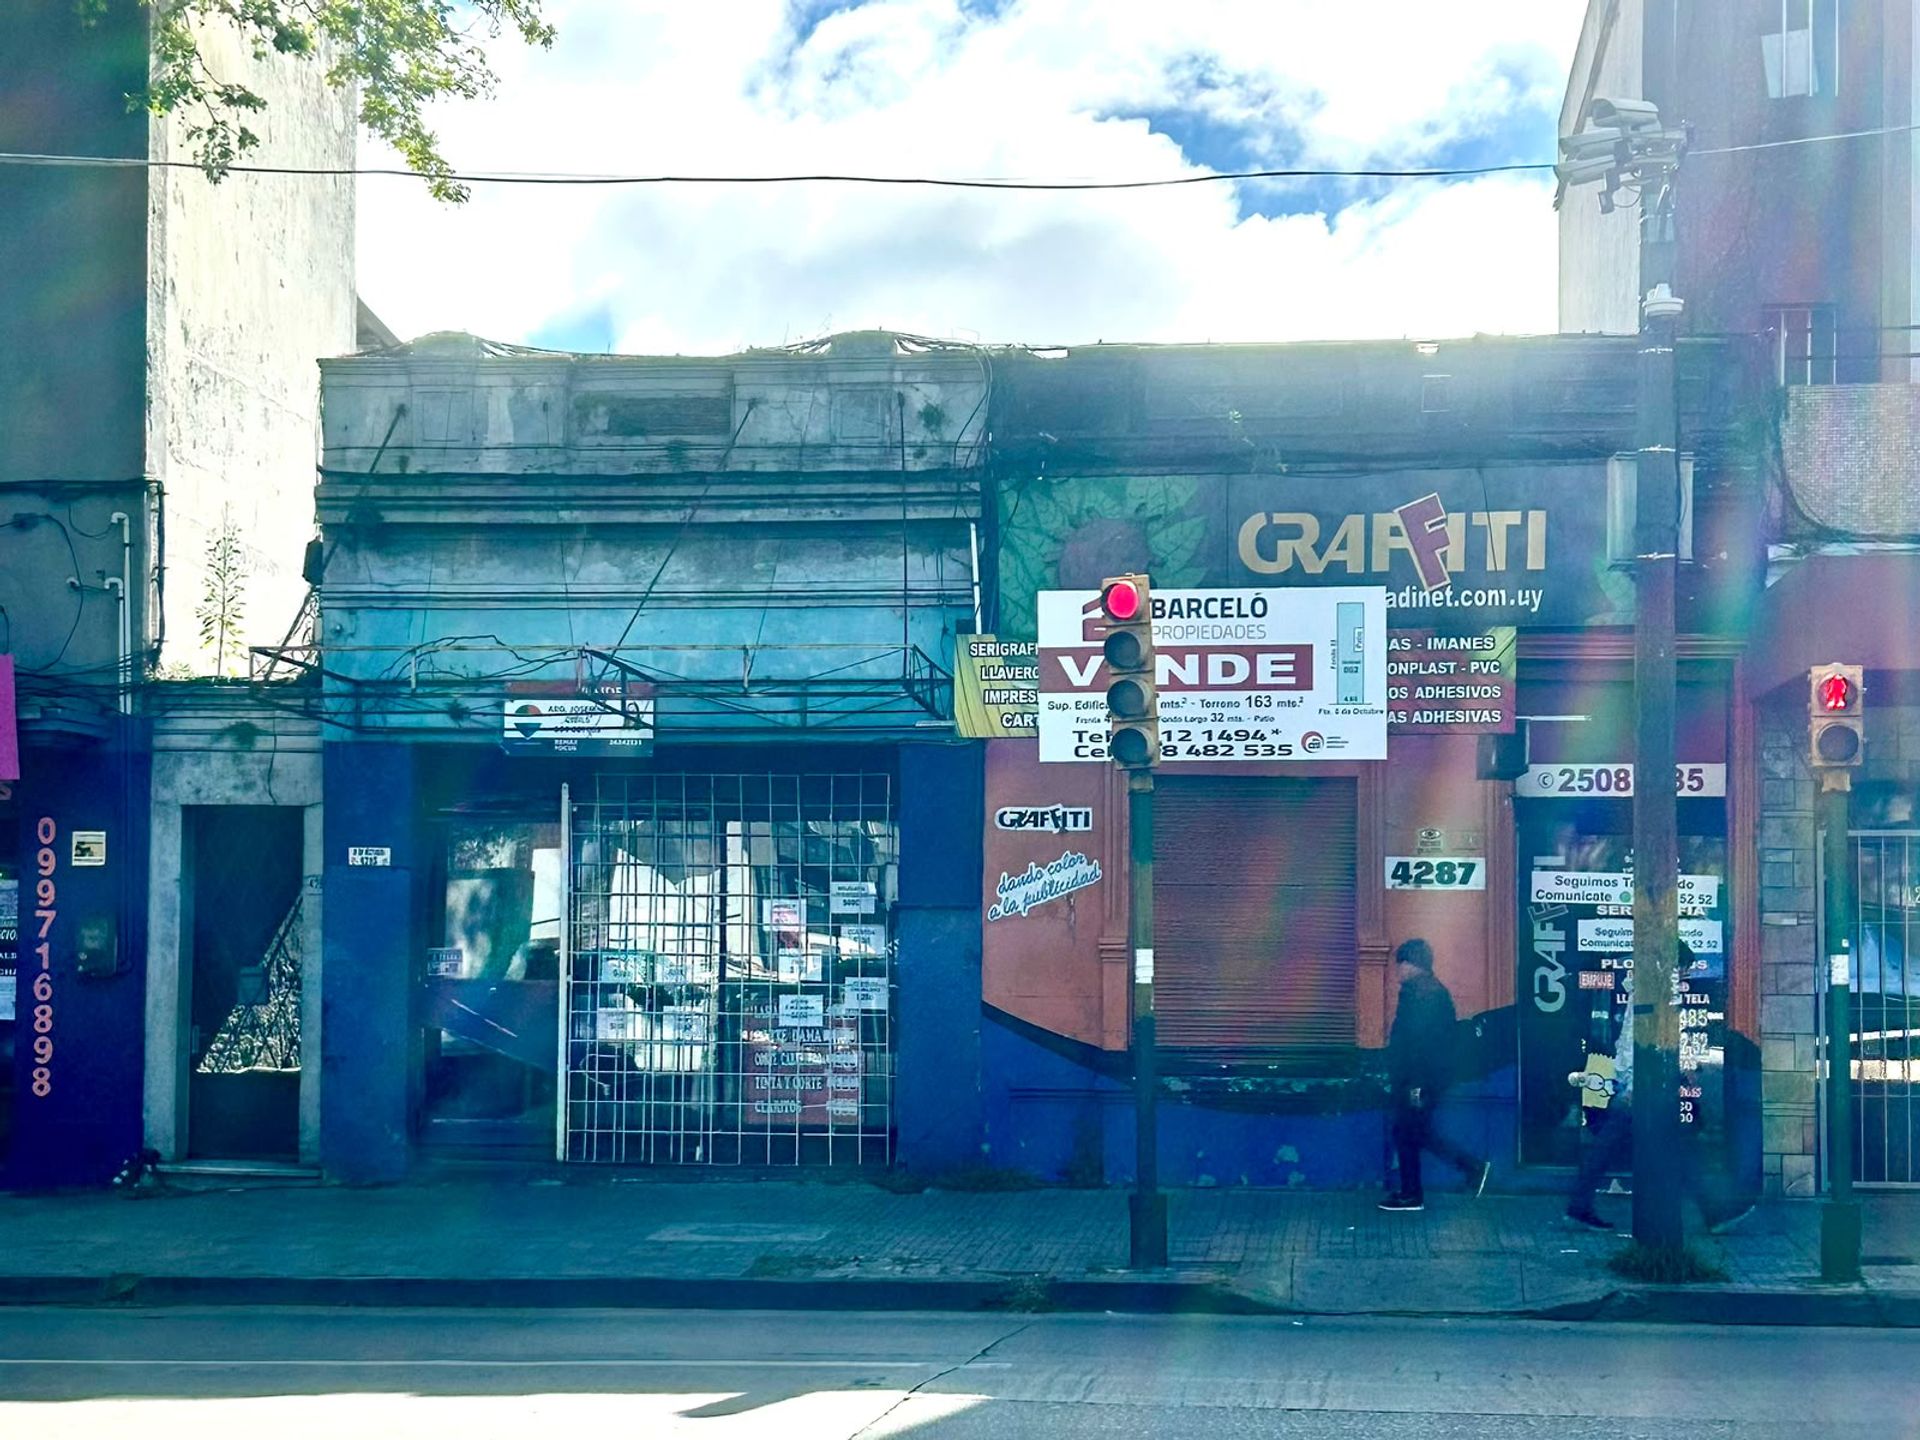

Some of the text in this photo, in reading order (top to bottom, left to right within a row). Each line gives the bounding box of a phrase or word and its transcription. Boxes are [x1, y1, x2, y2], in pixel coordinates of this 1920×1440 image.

[1238, 492, 1547, 591] GRAFFITI
[1152, 593, 1268, 619] BARCELÓ
[1152, 625, 1267, 640] PROPIEDADES
[1427, 638, 1495, 650] IMANES
[1057, 653, 1296, 686] VNDE
[1470, 661, 1500, 674] PVC
[1415, 686, 1501, 699] ADHESIVOS
[1245, 695, 1272, 708] 163
[1210, 713, 1224, 722] 32
[1412, 710, 1502, 723] ADHESIVAS
[1185, 744, 1234, 757] 482
[1244, 744, 1293, 756] 535
[998, 808, 1090, 829] GRAFFITI
[1047, 853, 1085, 875] color
[1391, 861, 1477, 885] 4287
[1554, 875, 1619, 888] Seguimos
[989, 907, 1000, 919] a
[1023, 865, 1101, 912] publicidad
[1535, 889, 1612, 902] Comunicate
[1595, 927, 1633, 938] Seguim
